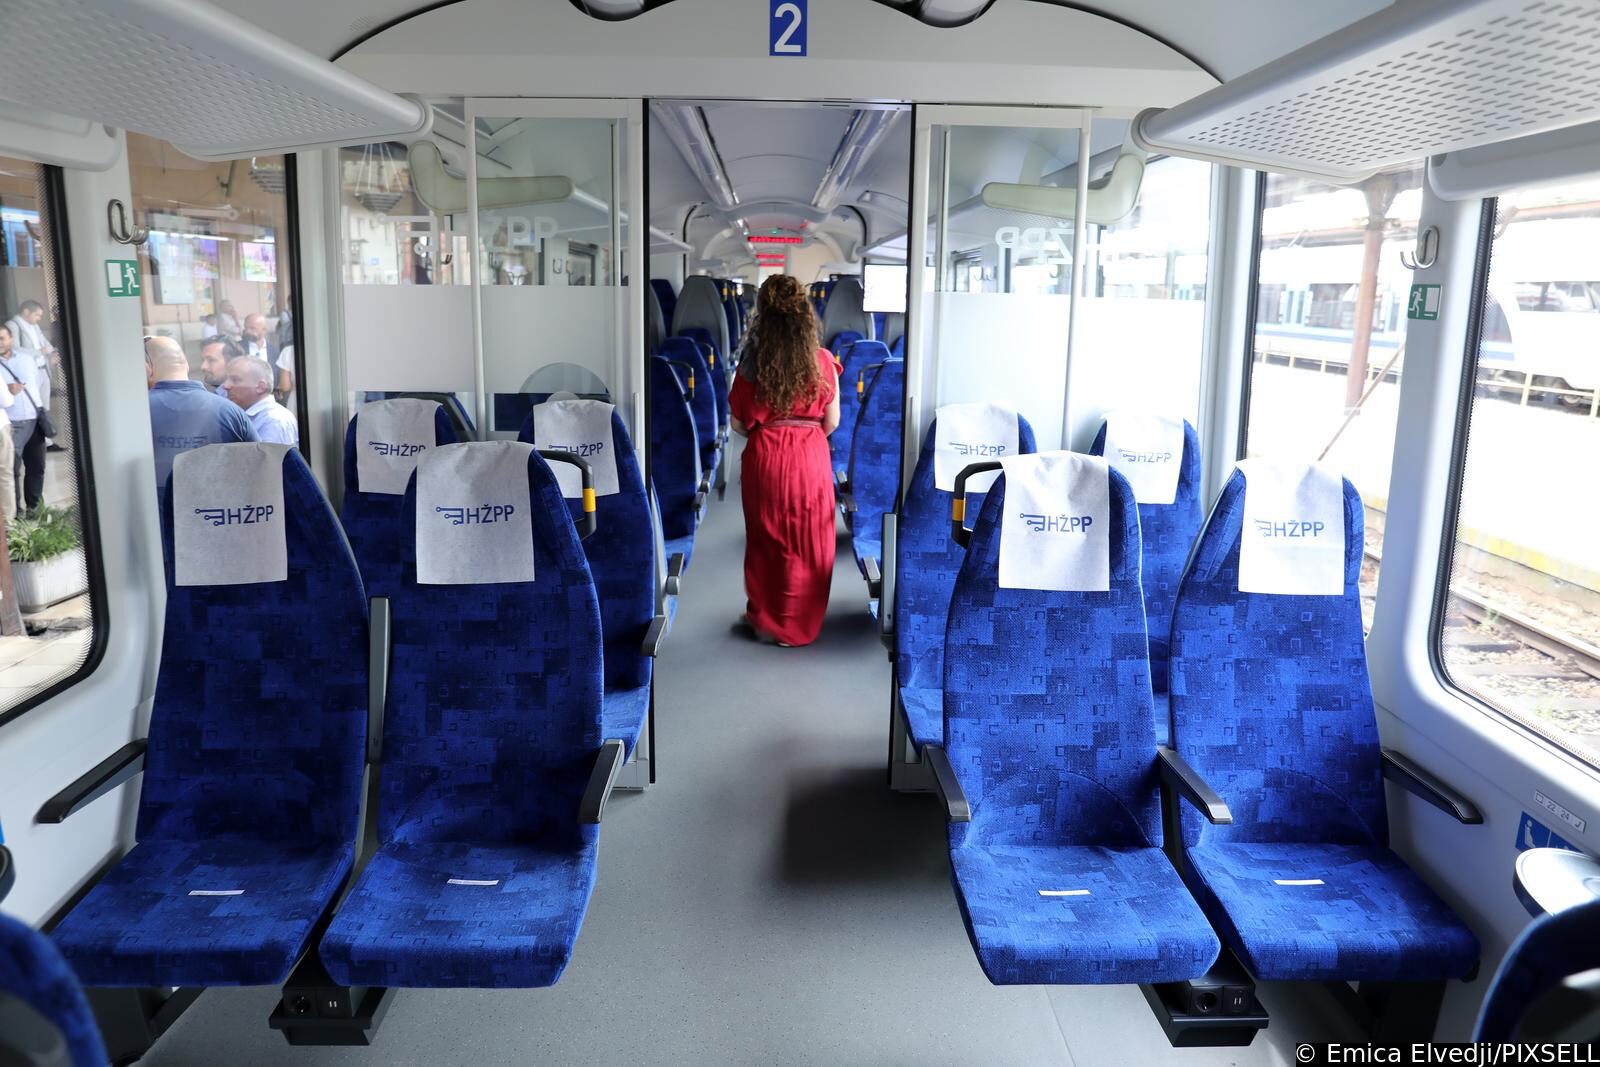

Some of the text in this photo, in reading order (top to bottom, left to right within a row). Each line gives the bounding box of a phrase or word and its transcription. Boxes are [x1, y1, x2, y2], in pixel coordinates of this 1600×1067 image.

[773, 2, 802, 53] 2
[227, 504, 274, 525] HŽPP
[466, 503, 515, 525] HŽPP
[1047, 513, 1093, 533] HŽPP
[1274, 519, 1325, 538] HŽPP
